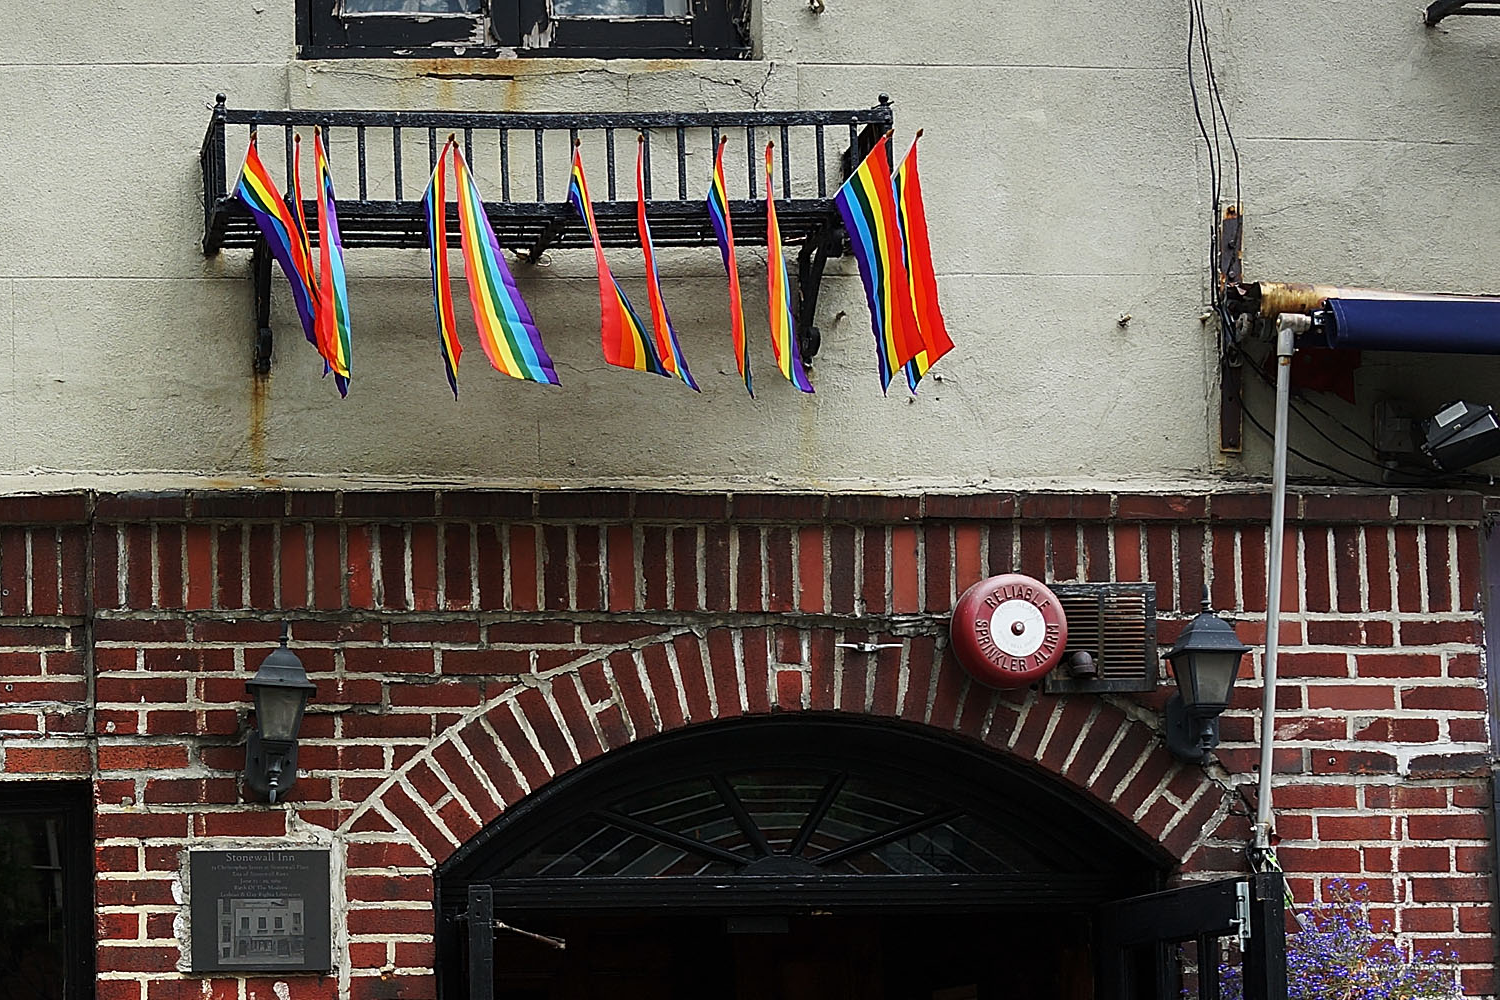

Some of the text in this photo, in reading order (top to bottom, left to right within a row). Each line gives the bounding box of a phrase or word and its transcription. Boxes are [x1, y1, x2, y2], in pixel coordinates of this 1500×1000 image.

[985, 585, 1050, 611] RELIABLE
[975, 619, 1059, 671] SPRINKLER ALARM
[226, 853, 295, 862] Stonewall Inn
